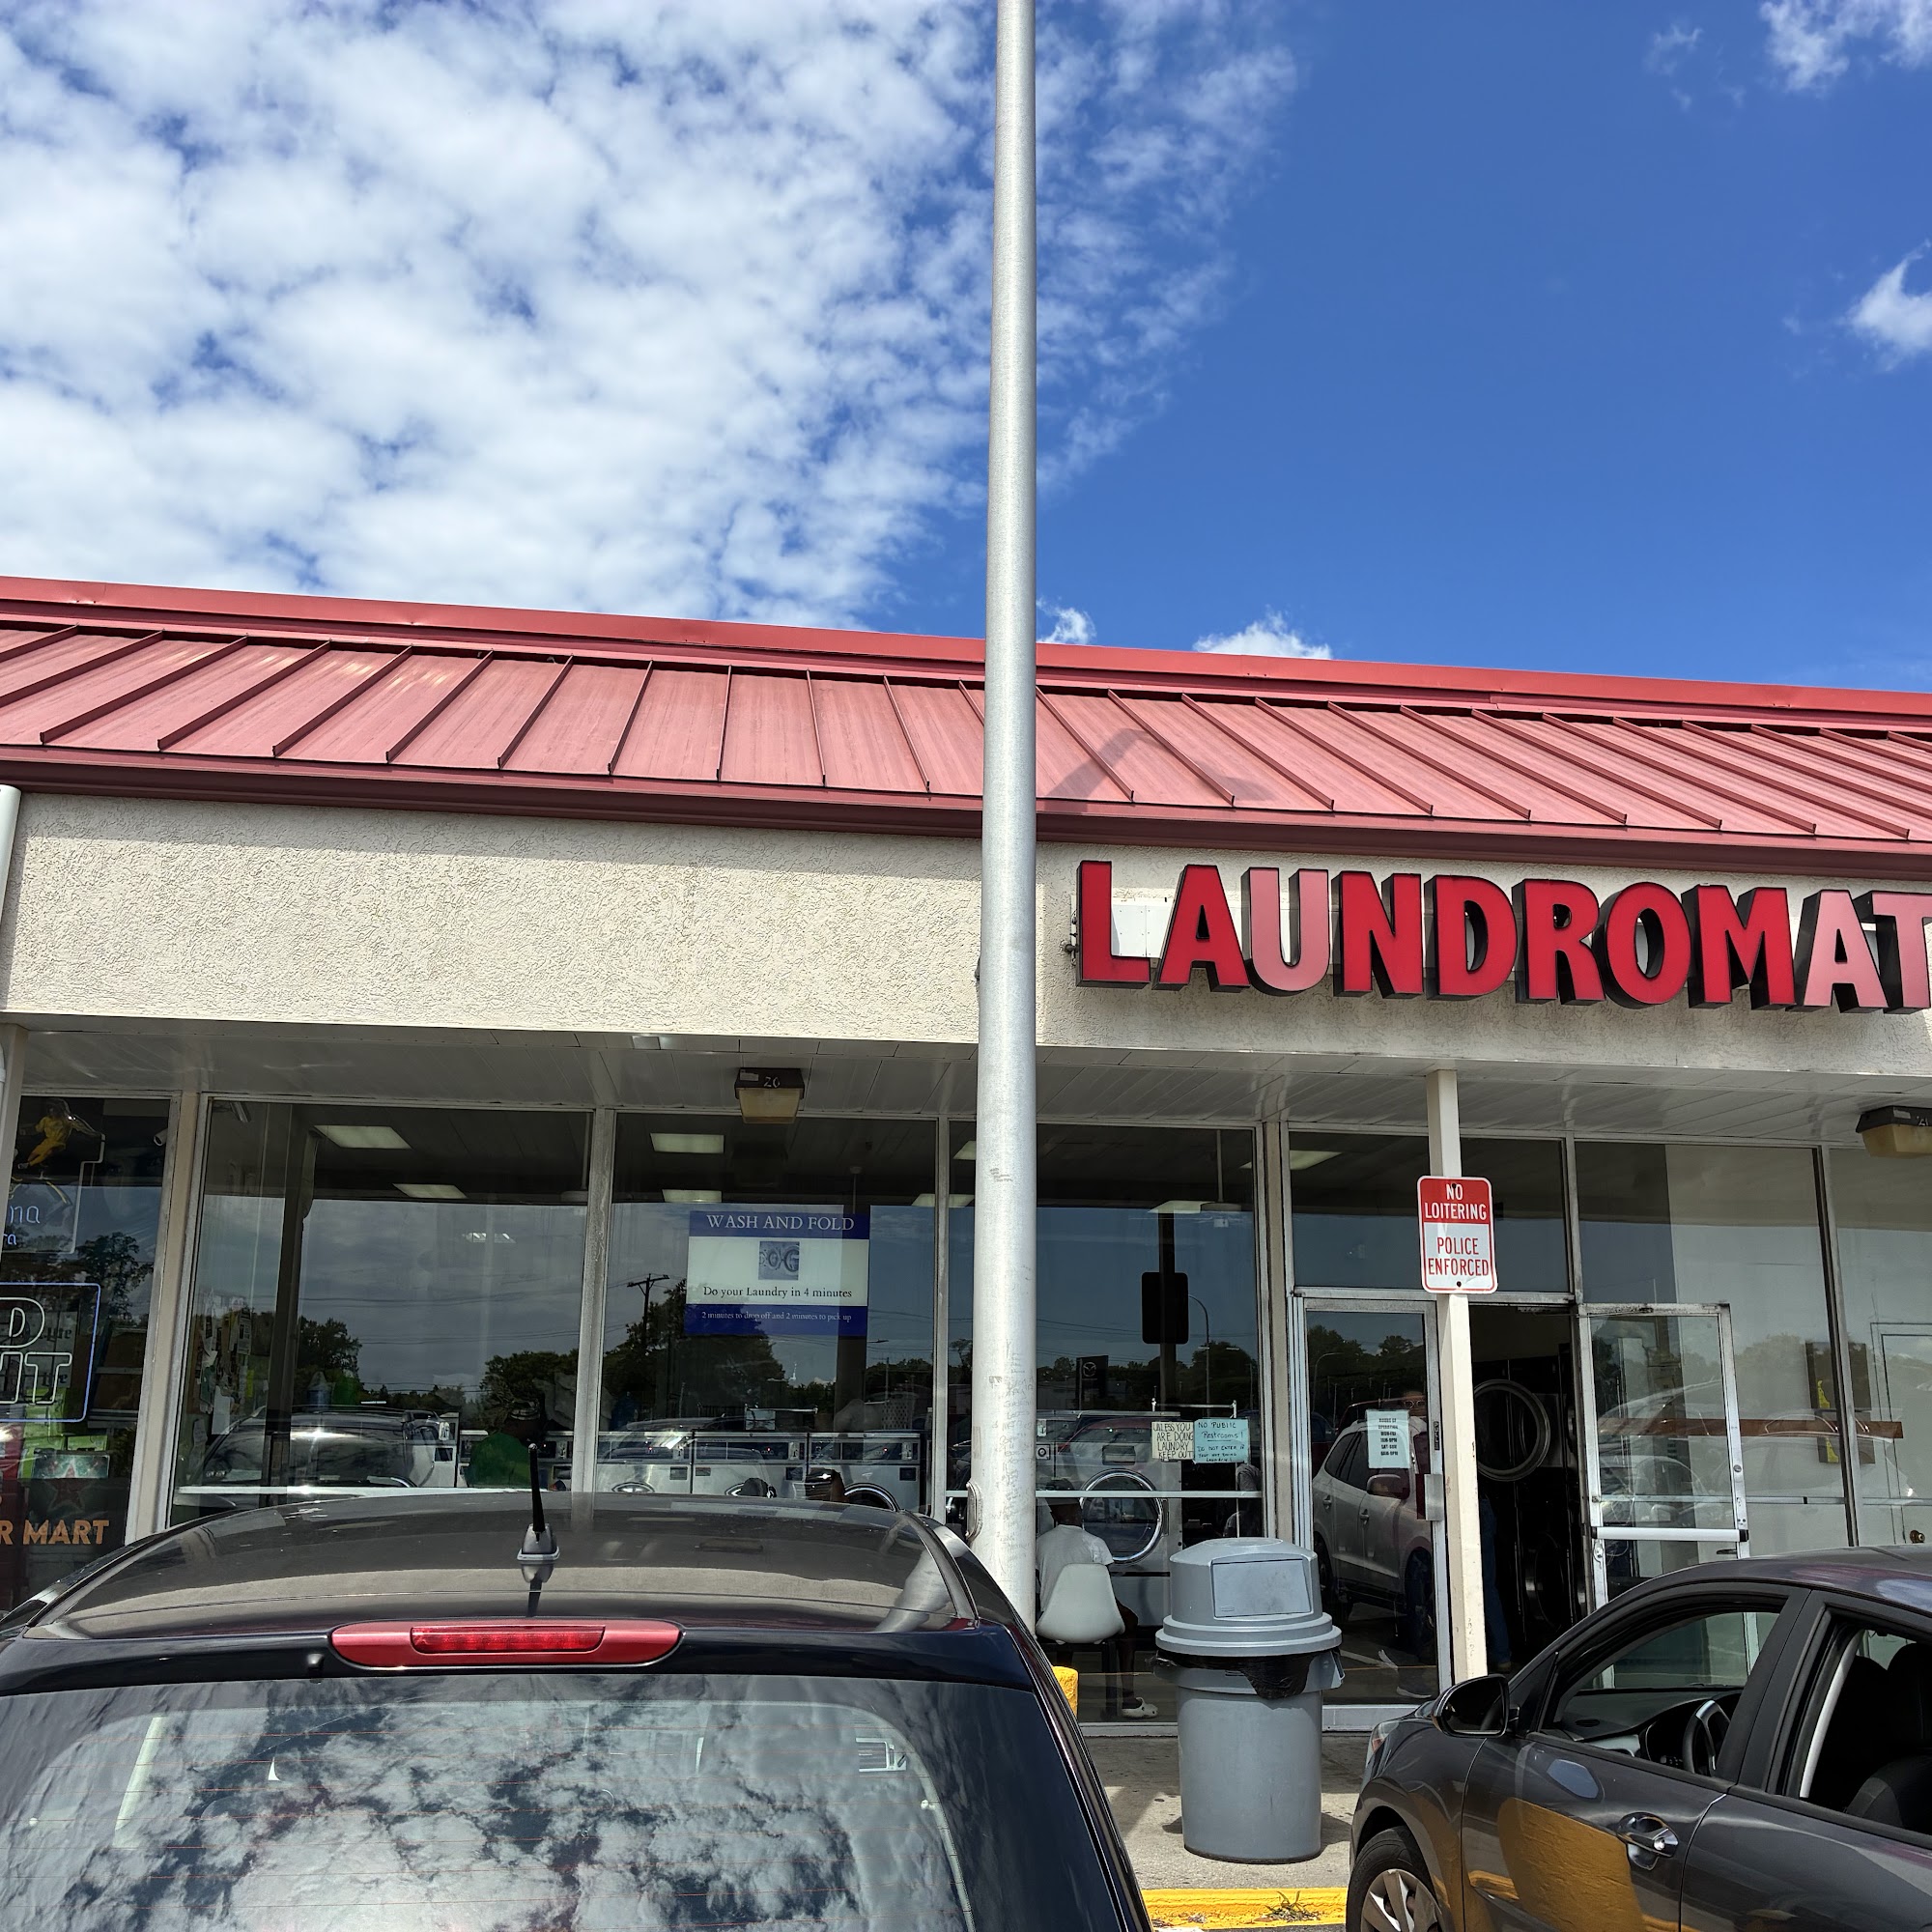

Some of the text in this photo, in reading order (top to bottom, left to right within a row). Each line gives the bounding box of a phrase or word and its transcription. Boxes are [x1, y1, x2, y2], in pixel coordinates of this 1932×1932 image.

[1076, 859, 1932, 1013] LAUNDROMAT
[1445, 1183, 1463, 1200] NO
[1424, 1202, 1487, 1220] LOITERING
[706, 1214, 855, 1231] WASH AND FOLD
[1436, 1236, 1479, 1255] POLICE
[1428, 1258, 1489, 1276] ENFORCED
[703, 1286, 852, 1298] Do your Laundry in 4 minutes
[744, 1311, 760, 1321] drop
[827, 1313, 841, 1321] pick
[1153, 1422, 1191, 1432] UNLESS YOU
[1156, 1432, 1194, 1441] ARE DOING
[1158, 1441, 1190, 1451] LAUNDRY
[1158, 1450, 1193, 1460] KEEP OUT
[22, 1520, 110, 1546] MART
